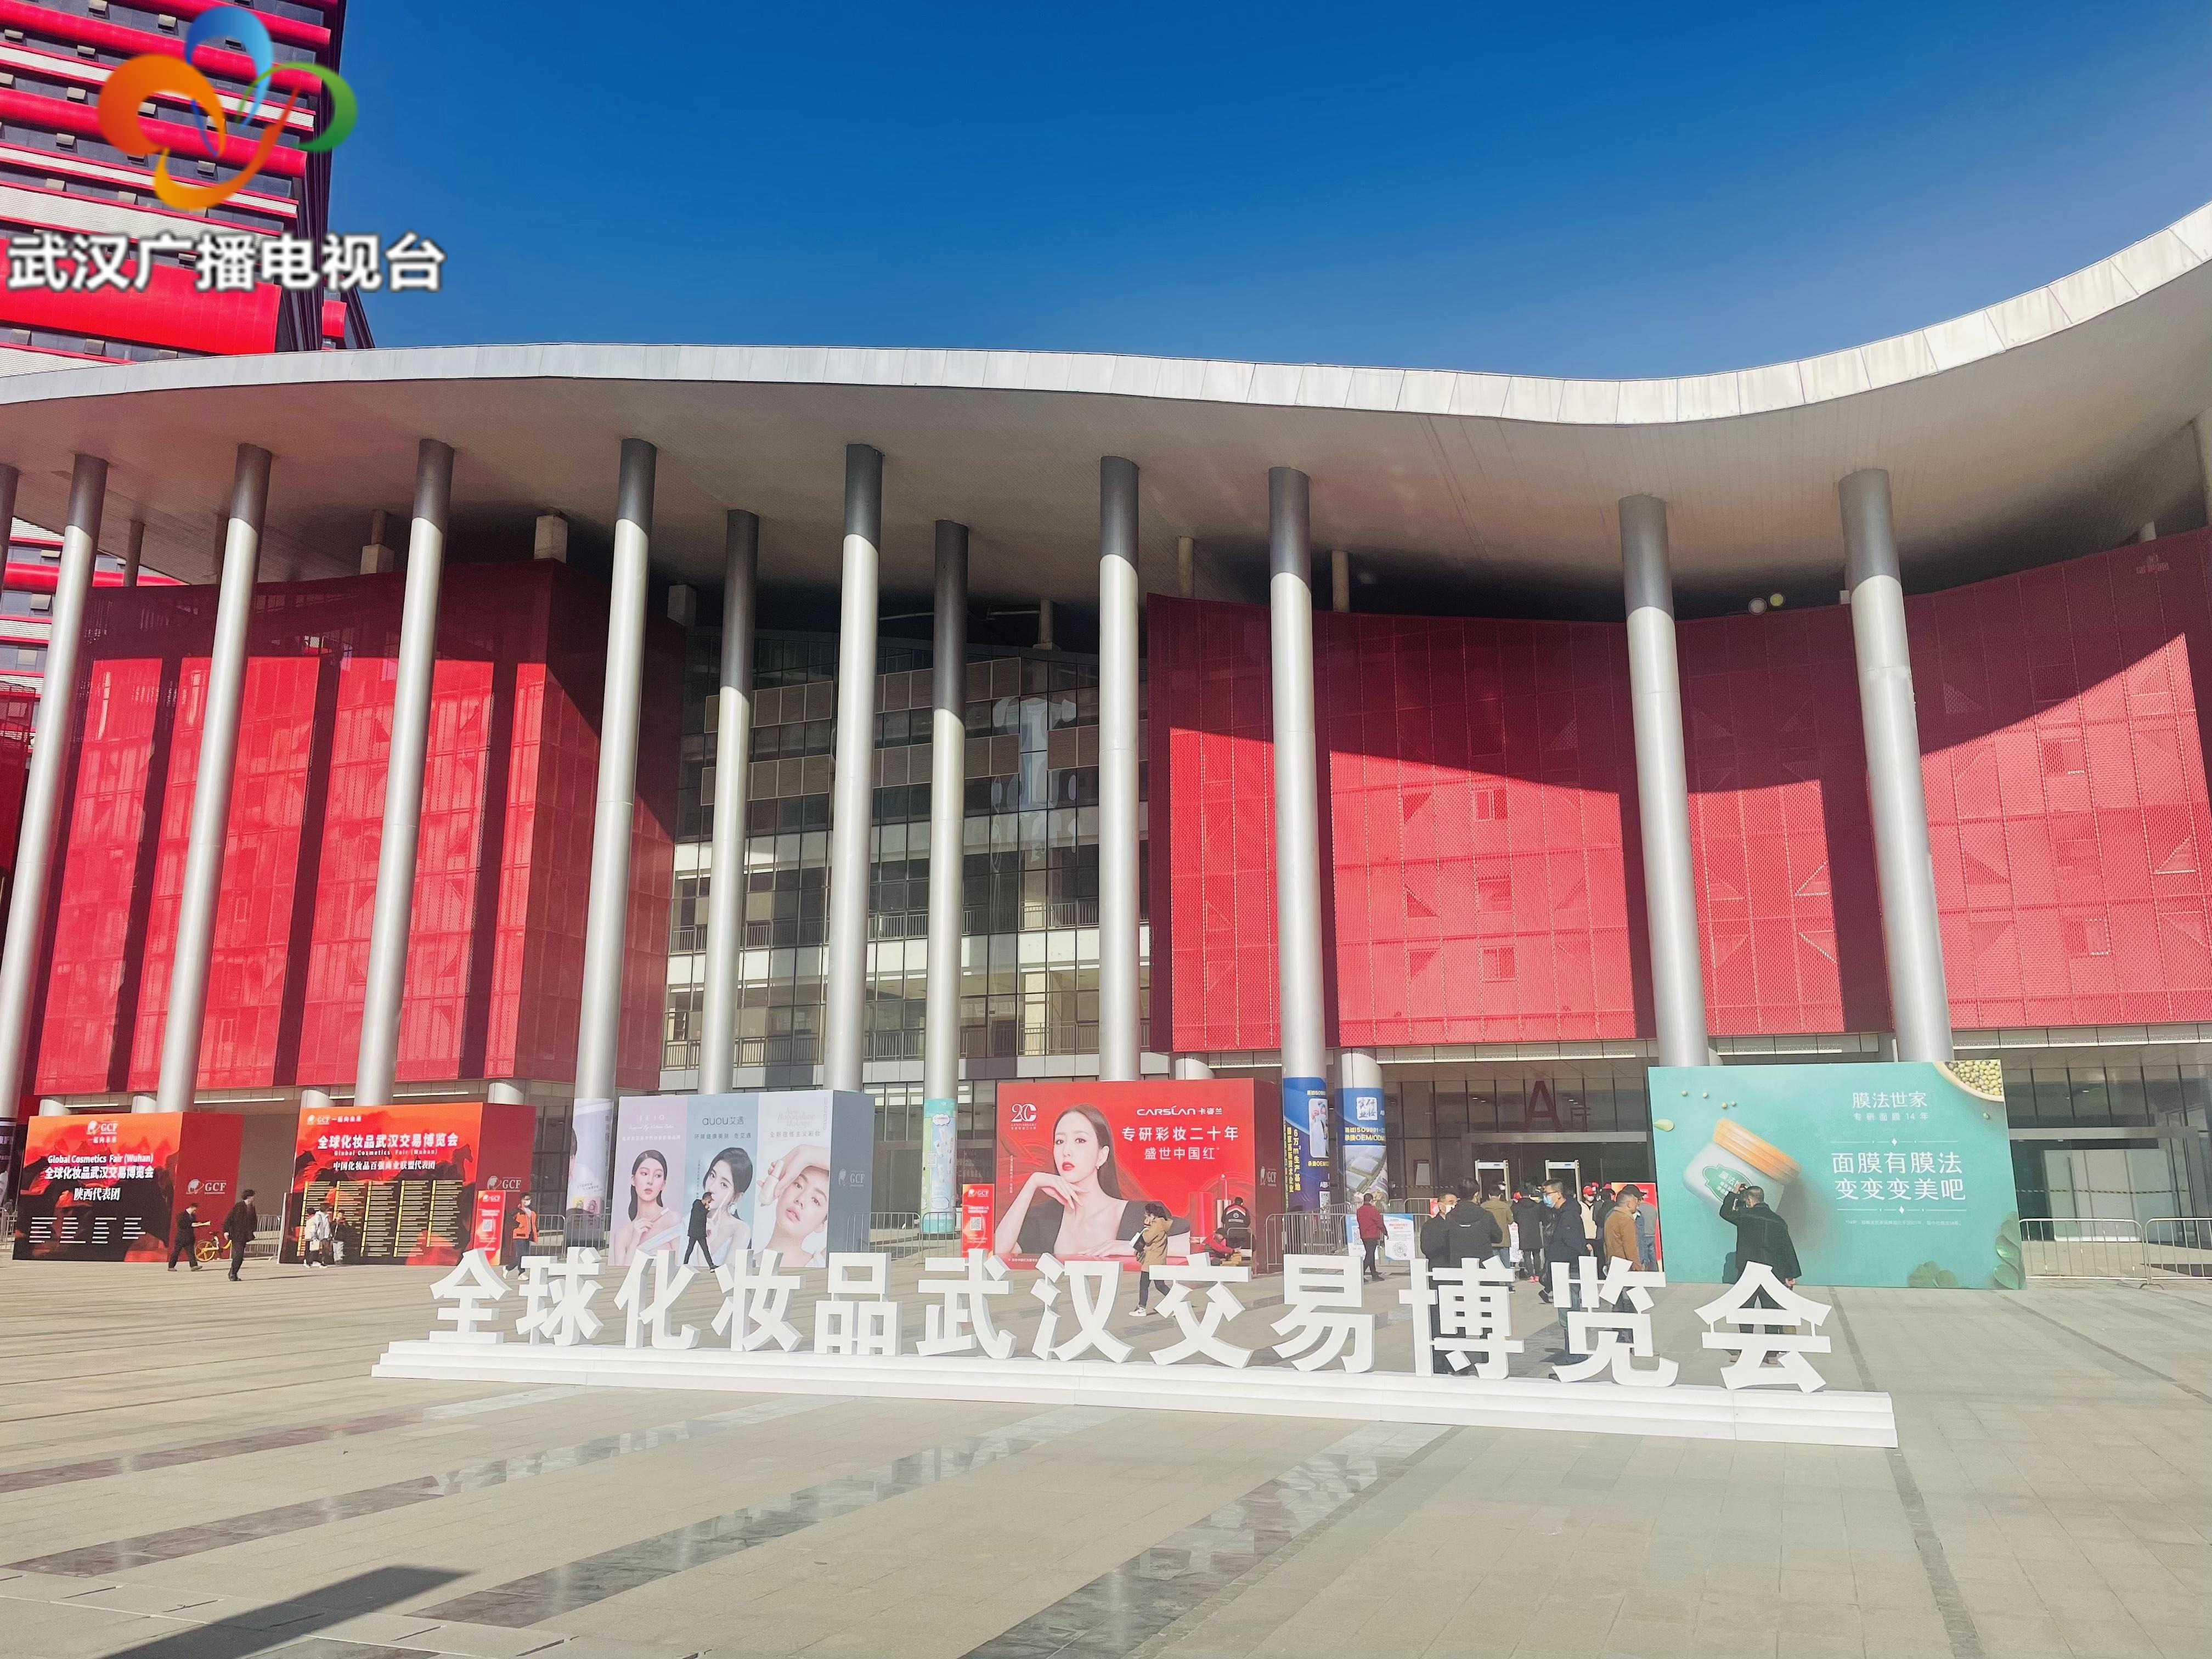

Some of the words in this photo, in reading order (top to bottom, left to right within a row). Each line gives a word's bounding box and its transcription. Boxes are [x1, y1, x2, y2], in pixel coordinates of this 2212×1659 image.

[1852, 1091, 1927, 1109] 膜法世家
[1198, 1107, 1223, 1115] 卡姿兰
[100, 1123, 119, 1132] GCF
[1121, 1125, 1239, 1142] 专研彩妆二十年
[317, 1132, 459, 1149] 全球化妆品武汉交易博览会
[48, 1154, 71, 1164] Global
[71, 1154, 107, 1164] Cosmetics
[109, 1154, 123, 1163] Fair
[124, 1153, 154, 1164] (Wuhan)
[1831, 1151, 1963, 1175] 面膜有膜法
[44, 1165, 155, 1180] 全球化妆品武汉交易博览会
[850, 1173, 865, 1183] GCF
[1267, 1171, 1277, 1183] GCF
[205, 1182, 227, 1192] GCF
[502, 1179, 521, 1189] GCF
[1834, 1177, 1967, 1201] 变变变美吧
[74, 1187, 121, 1201] 陕西代表团
[429, 1248, 1833, 1393] 全球化妆品武汉交易博览会
